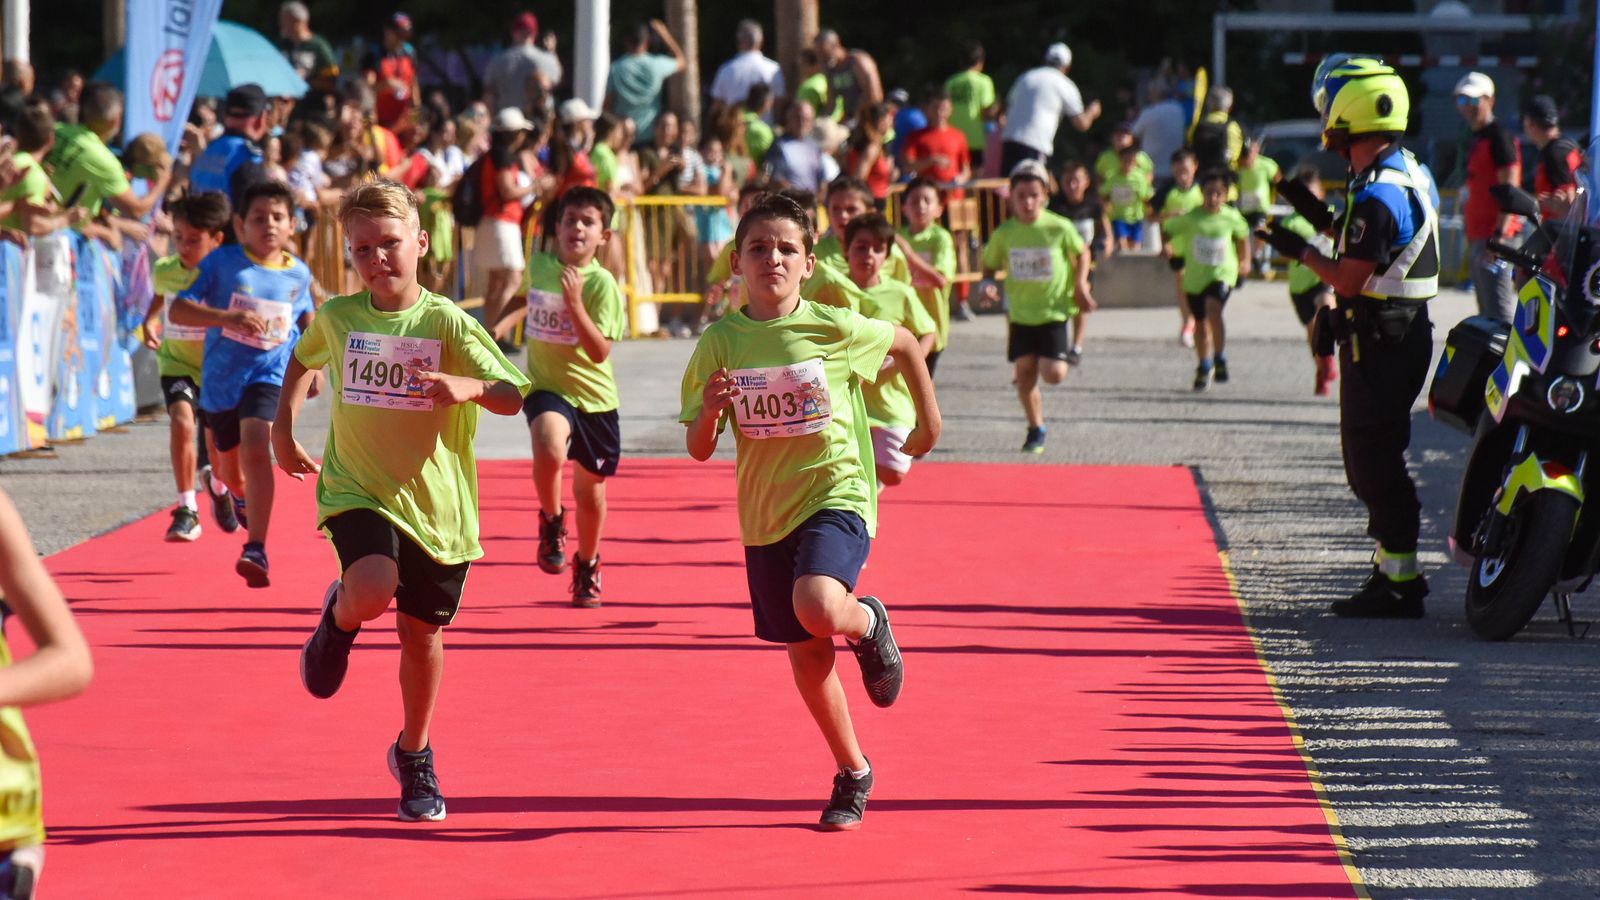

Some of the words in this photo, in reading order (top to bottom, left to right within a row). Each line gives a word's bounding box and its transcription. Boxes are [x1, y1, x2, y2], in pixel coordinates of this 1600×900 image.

[349, 338, 365, 350] XXI
[349, 358, 403, 388] 1490
[782, 368, 808, 377] ARTURO
[740, 393, 797, 420] 1403
